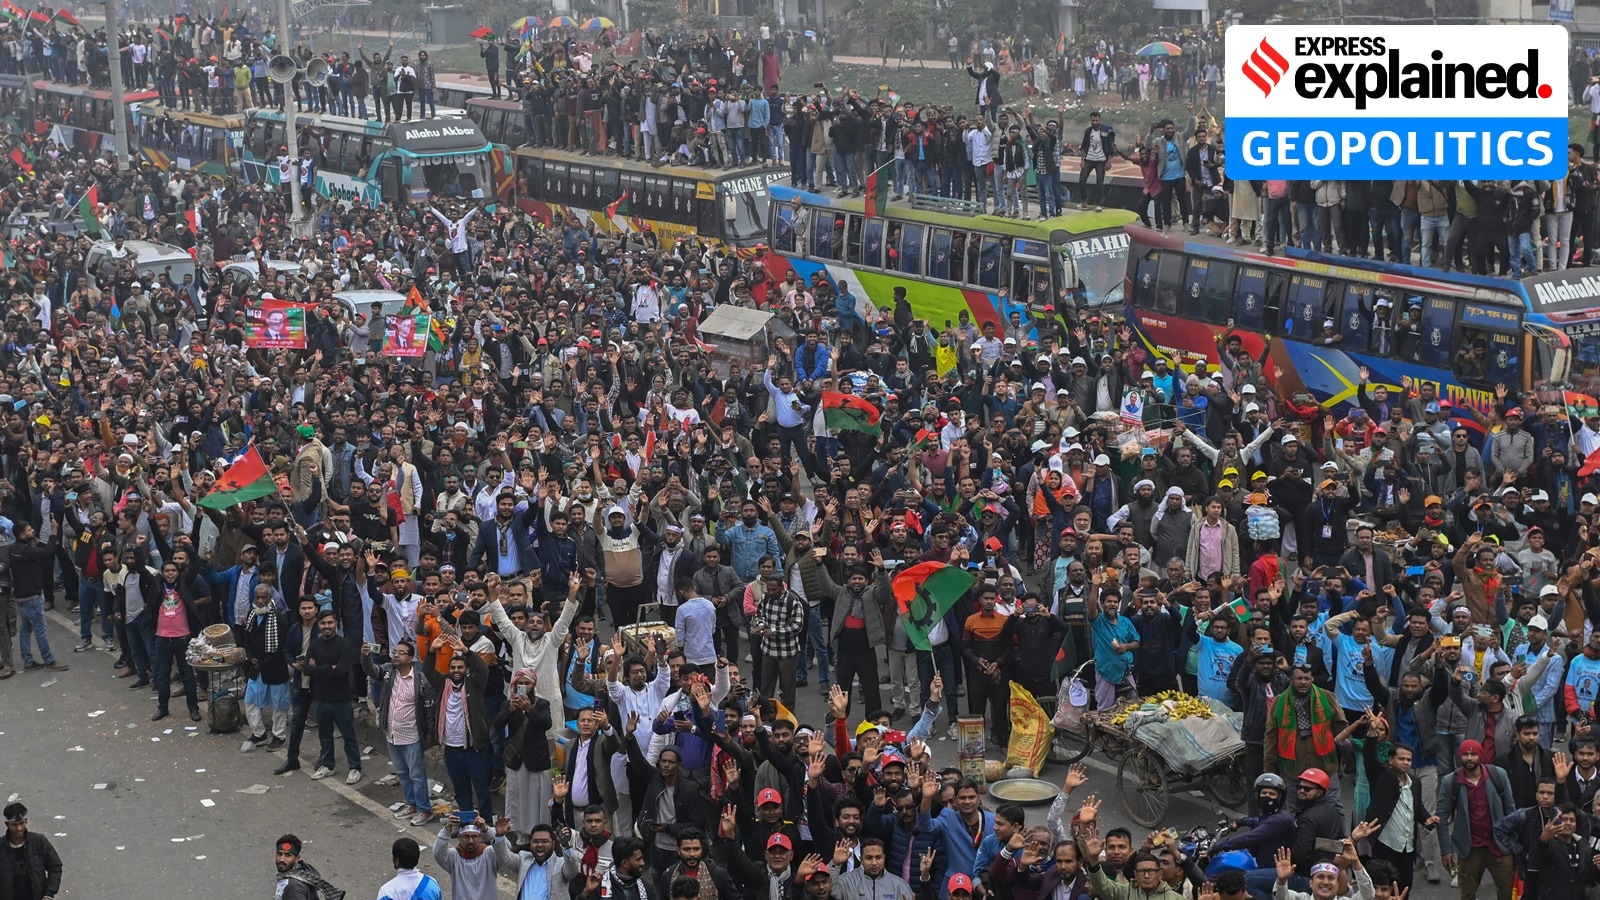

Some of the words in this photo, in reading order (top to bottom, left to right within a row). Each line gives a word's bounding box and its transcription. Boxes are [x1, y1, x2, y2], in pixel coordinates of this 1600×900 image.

[405, 128, 440, 140] Allahu
[442, 126, 475, 136] Akbar
[1071, 232, 1131, 256] RAHI
[1446, 384, 1495, 414] TRAVEL
